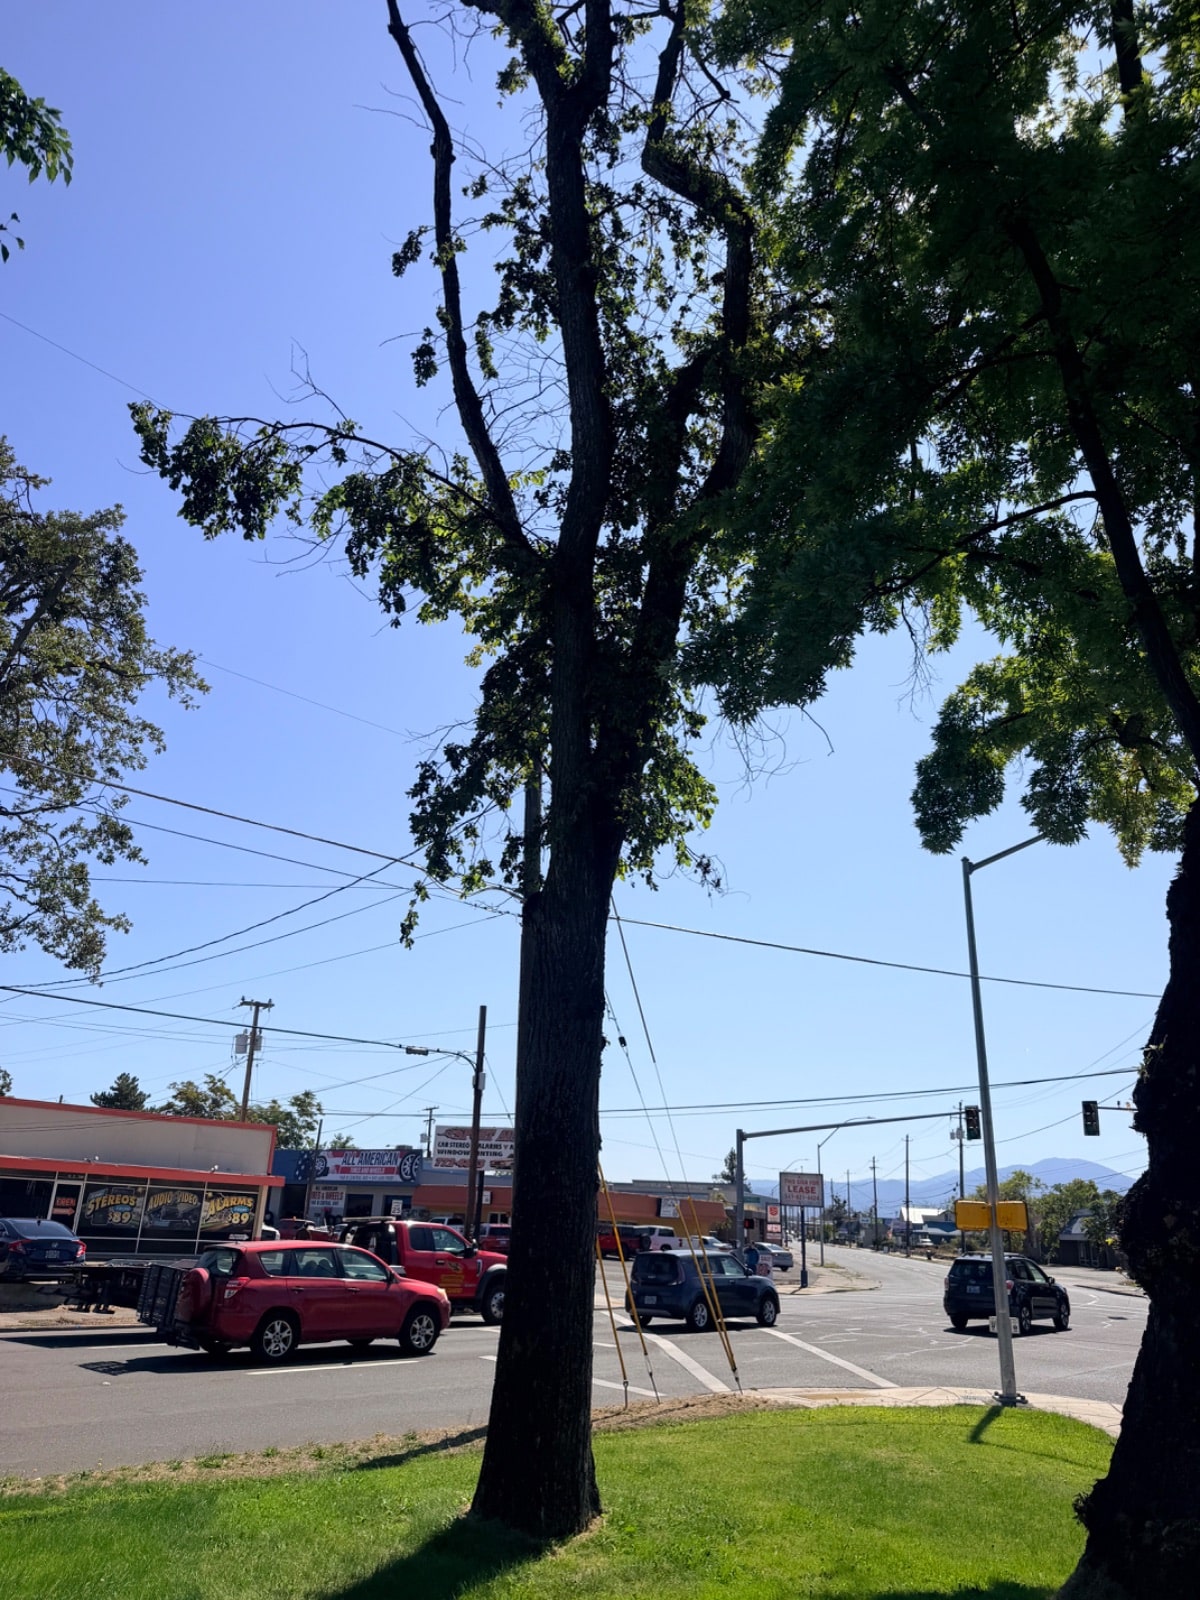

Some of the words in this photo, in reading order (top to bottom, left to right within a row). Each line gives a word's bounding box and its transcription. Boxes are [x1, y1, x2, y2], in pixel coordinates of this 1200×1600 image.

[341, 1151, 357, 1165] ALL
[357, 1151, 400, 1165] AMERICAN
[787, 1185, 816, 1194] LEASE
[86, 1194, 137, 1216] STEREOS
[147, 1191, 173, 1212] AUDIO
[176, 1192, 199, 1205] VIDEO
[207, 1196, 254, 1217] ALARMS
[108, 1212, 132, 1224] $89
[227, 1212, 250, 1224] $89
